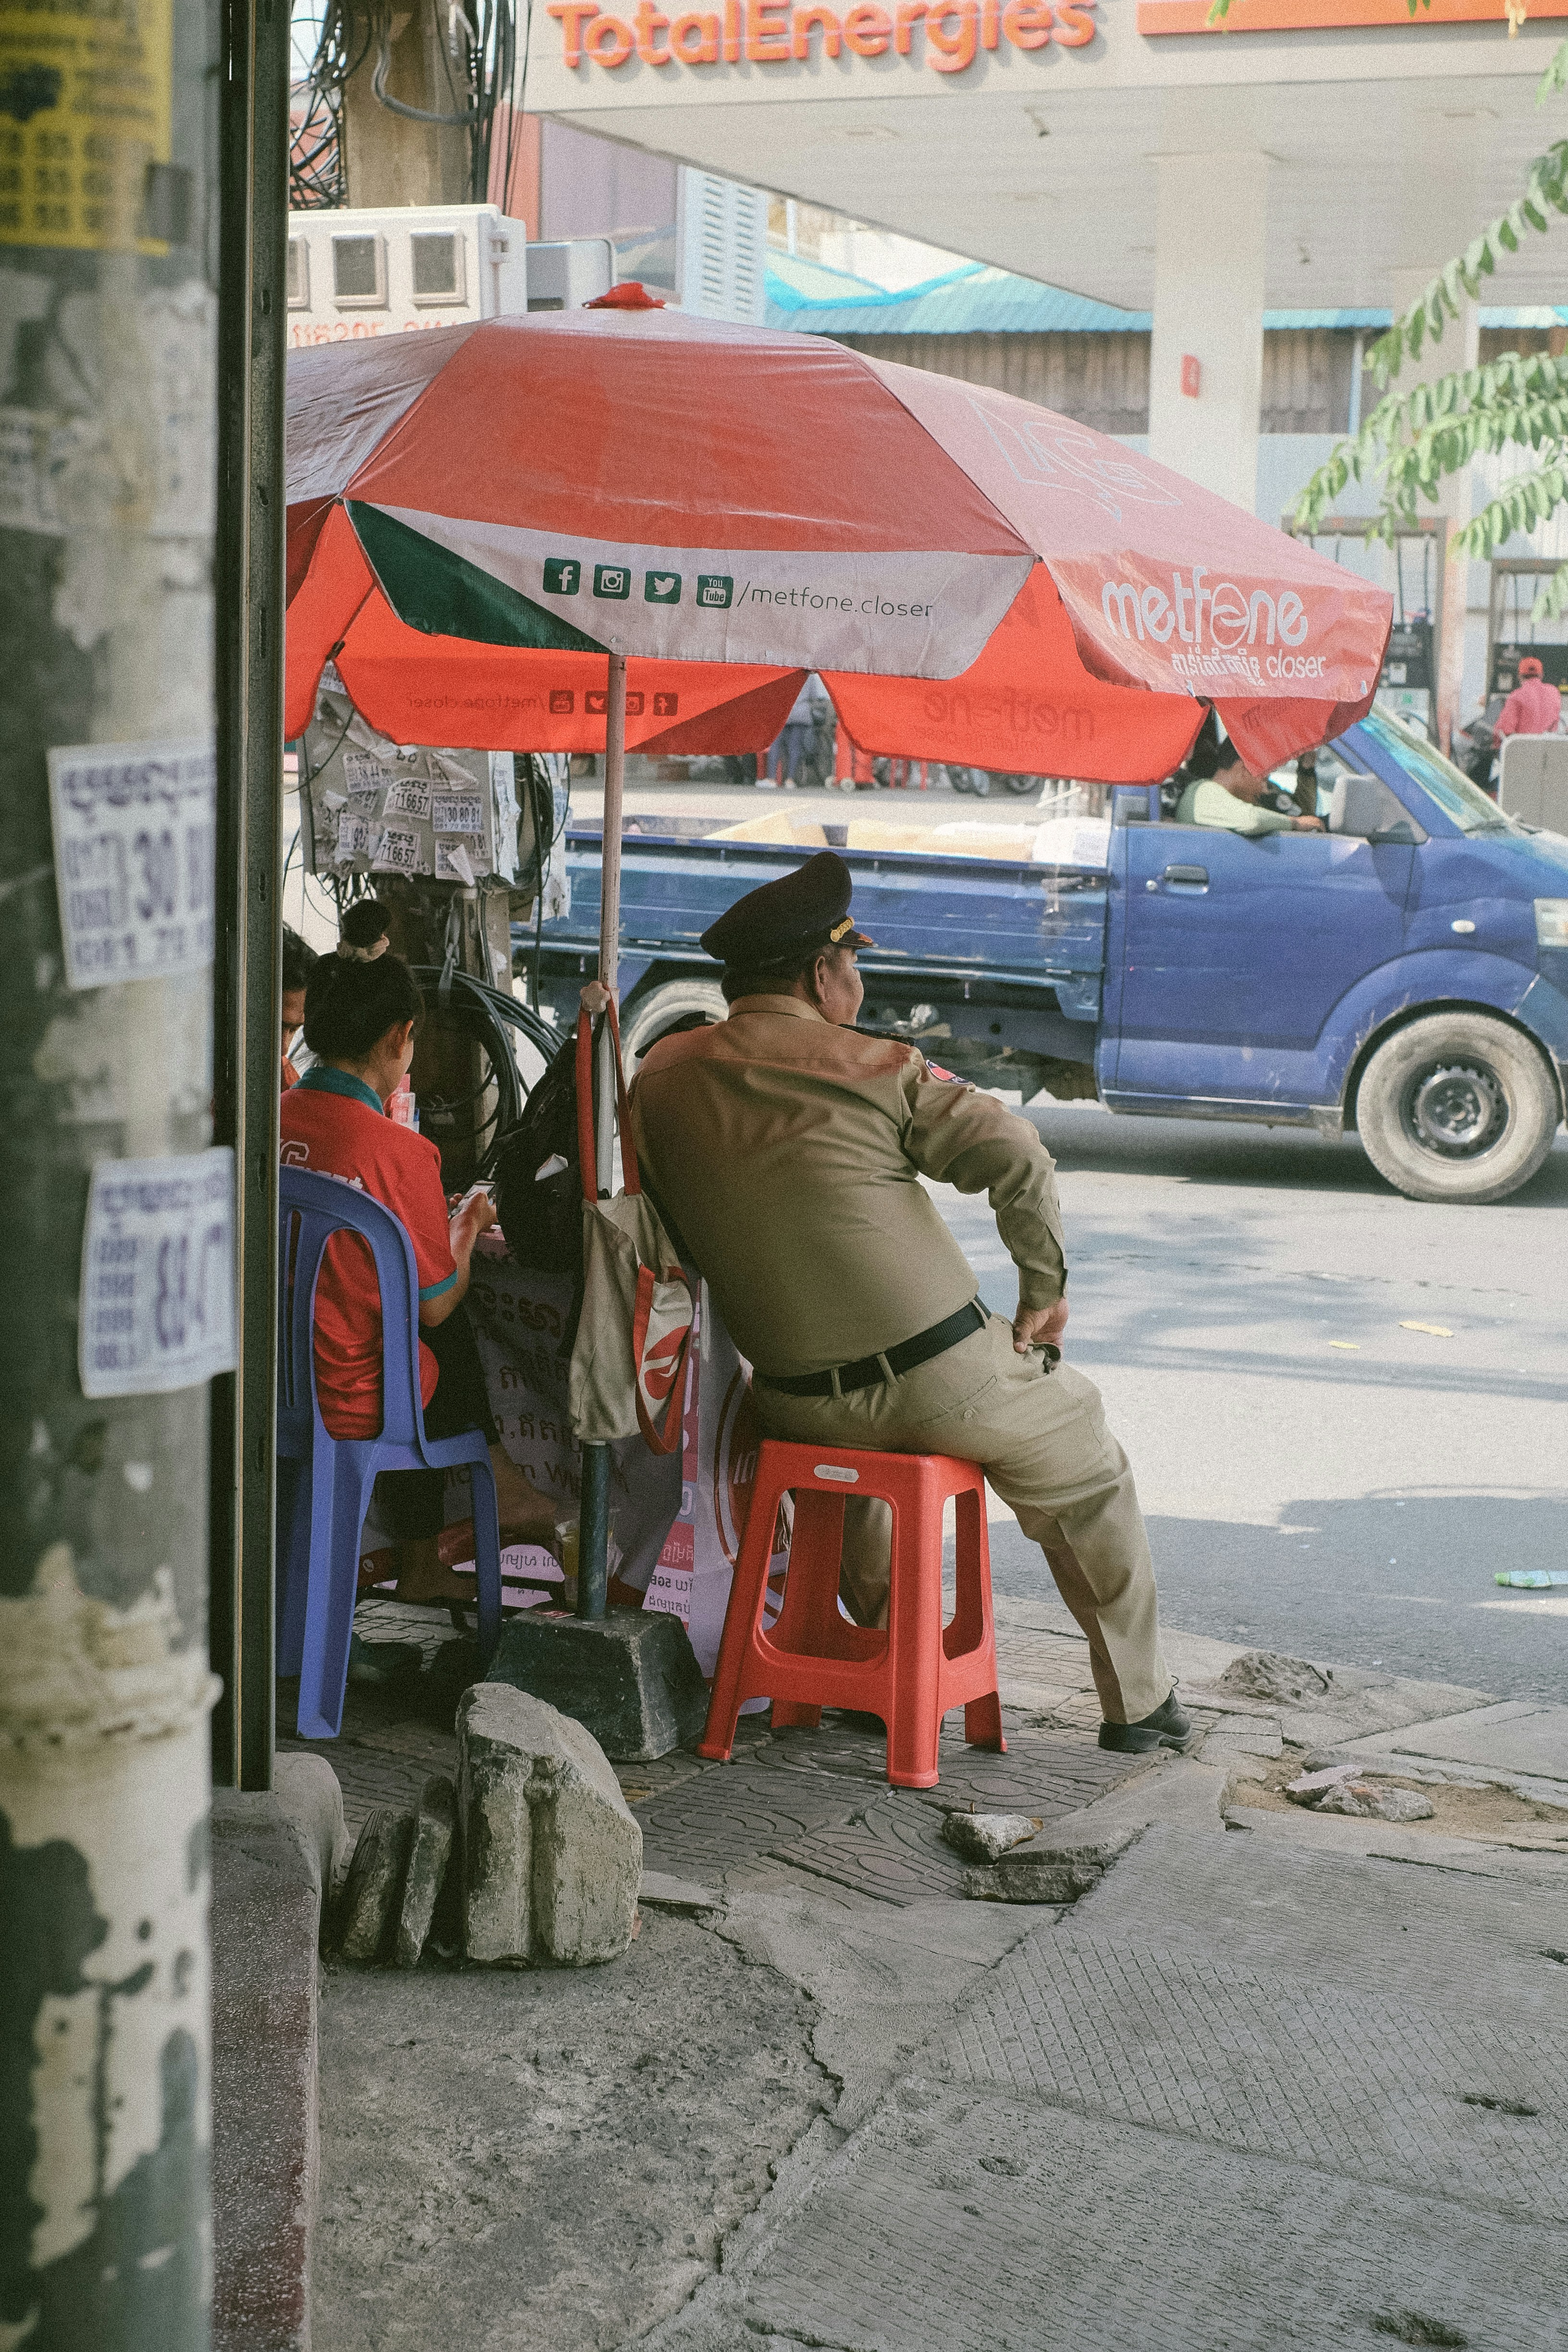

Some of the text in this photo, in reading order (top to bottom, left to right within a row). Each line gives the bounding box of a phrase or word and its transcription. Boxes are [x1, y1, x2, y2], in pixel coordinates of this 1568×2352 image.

[547, 0, 1097, 73] TotalEnergies
[704, 589, 726, 603] Tube
[707, 576, 723, 588] You
[1102, 565, 1309, 649] metfone
[1266, 649, 1326, 678] closer
